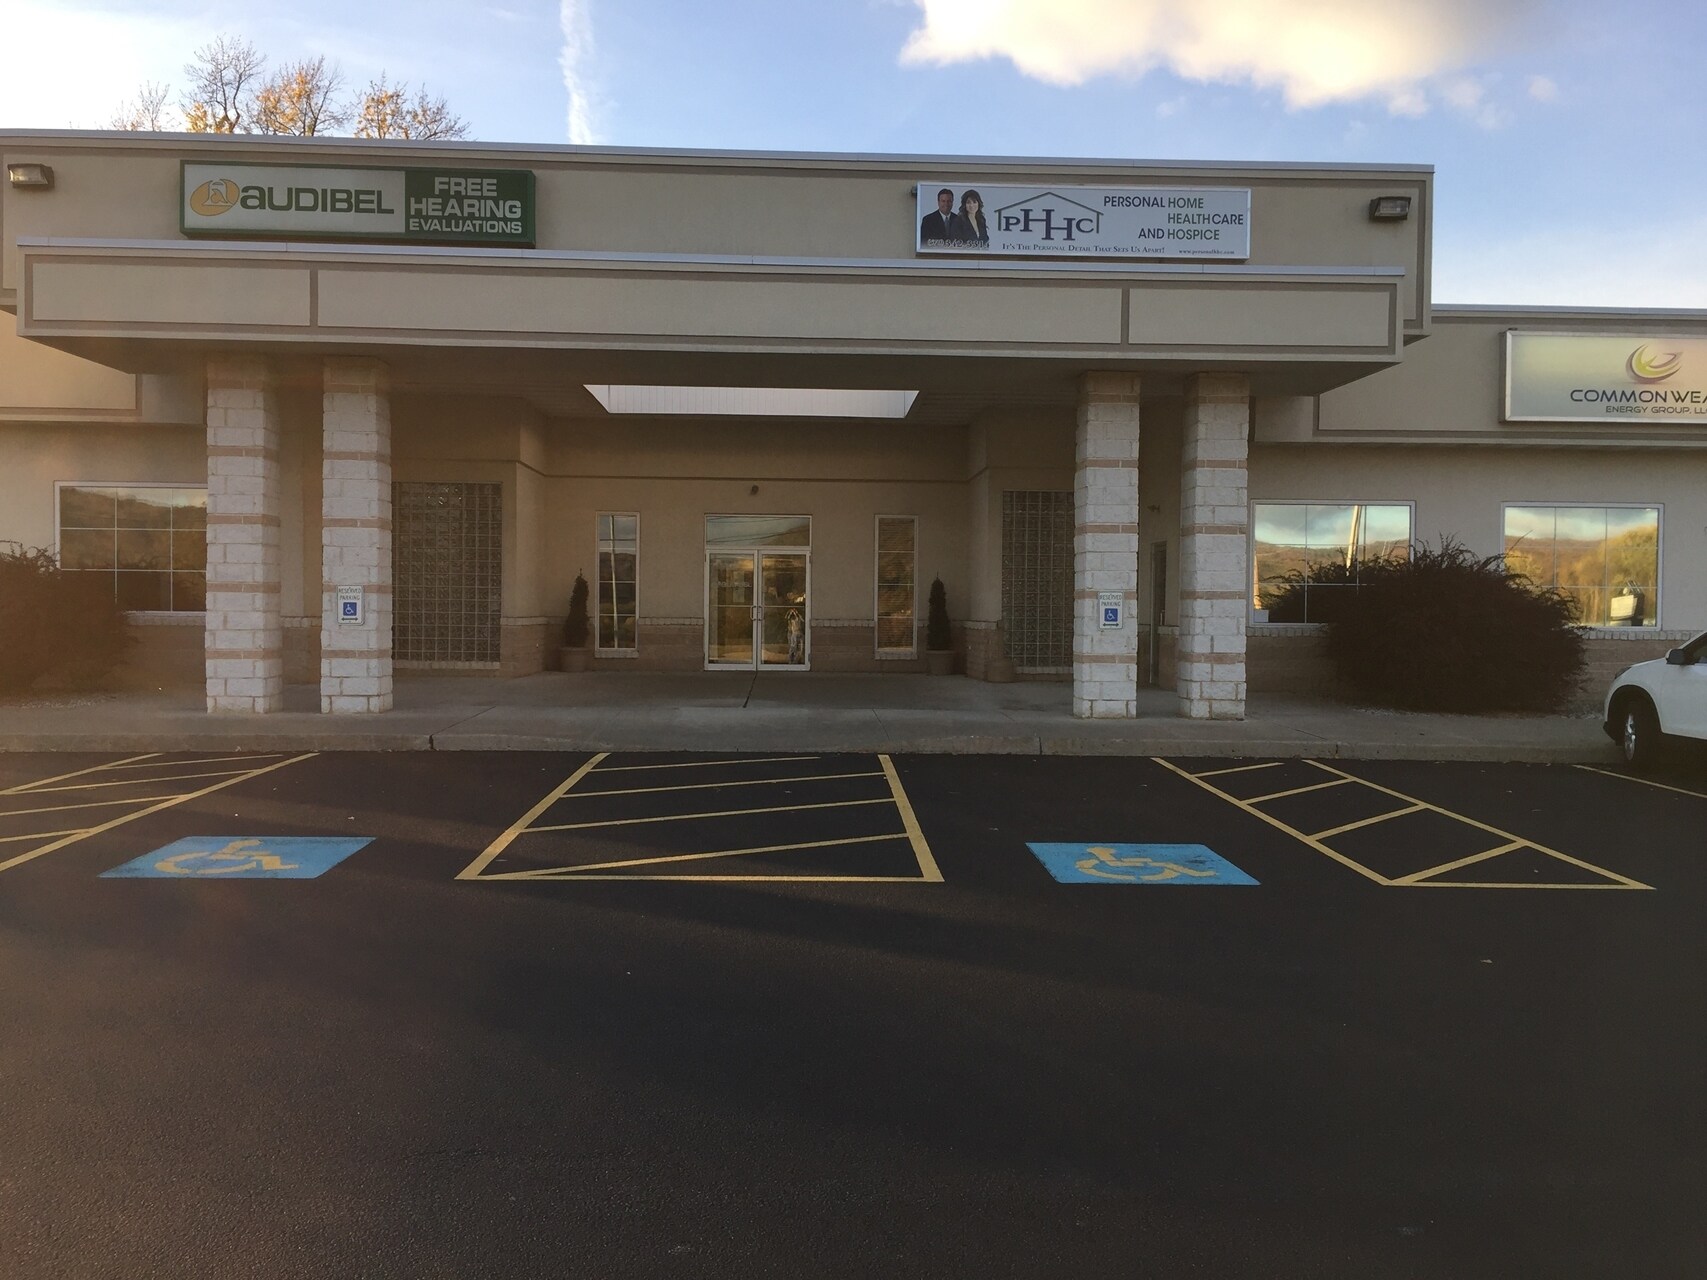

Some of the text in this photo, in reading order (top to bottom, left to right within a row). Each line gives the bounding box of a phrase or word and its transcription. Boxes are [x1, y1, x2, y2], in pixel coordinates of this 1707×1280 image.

[434, 177, 497, 197] FREE
[410, 197, 522, 219] HEARING
[1104, 196, 1204, 209] PERSONAL HOME
[409, 219, 522, 234] EVALUATIONS
[1138, 228, 1220, 240] AND HOSPICE
[1605, 405, 1648, 414] ENERGY
[1694, 407, 1707, 415] LL
